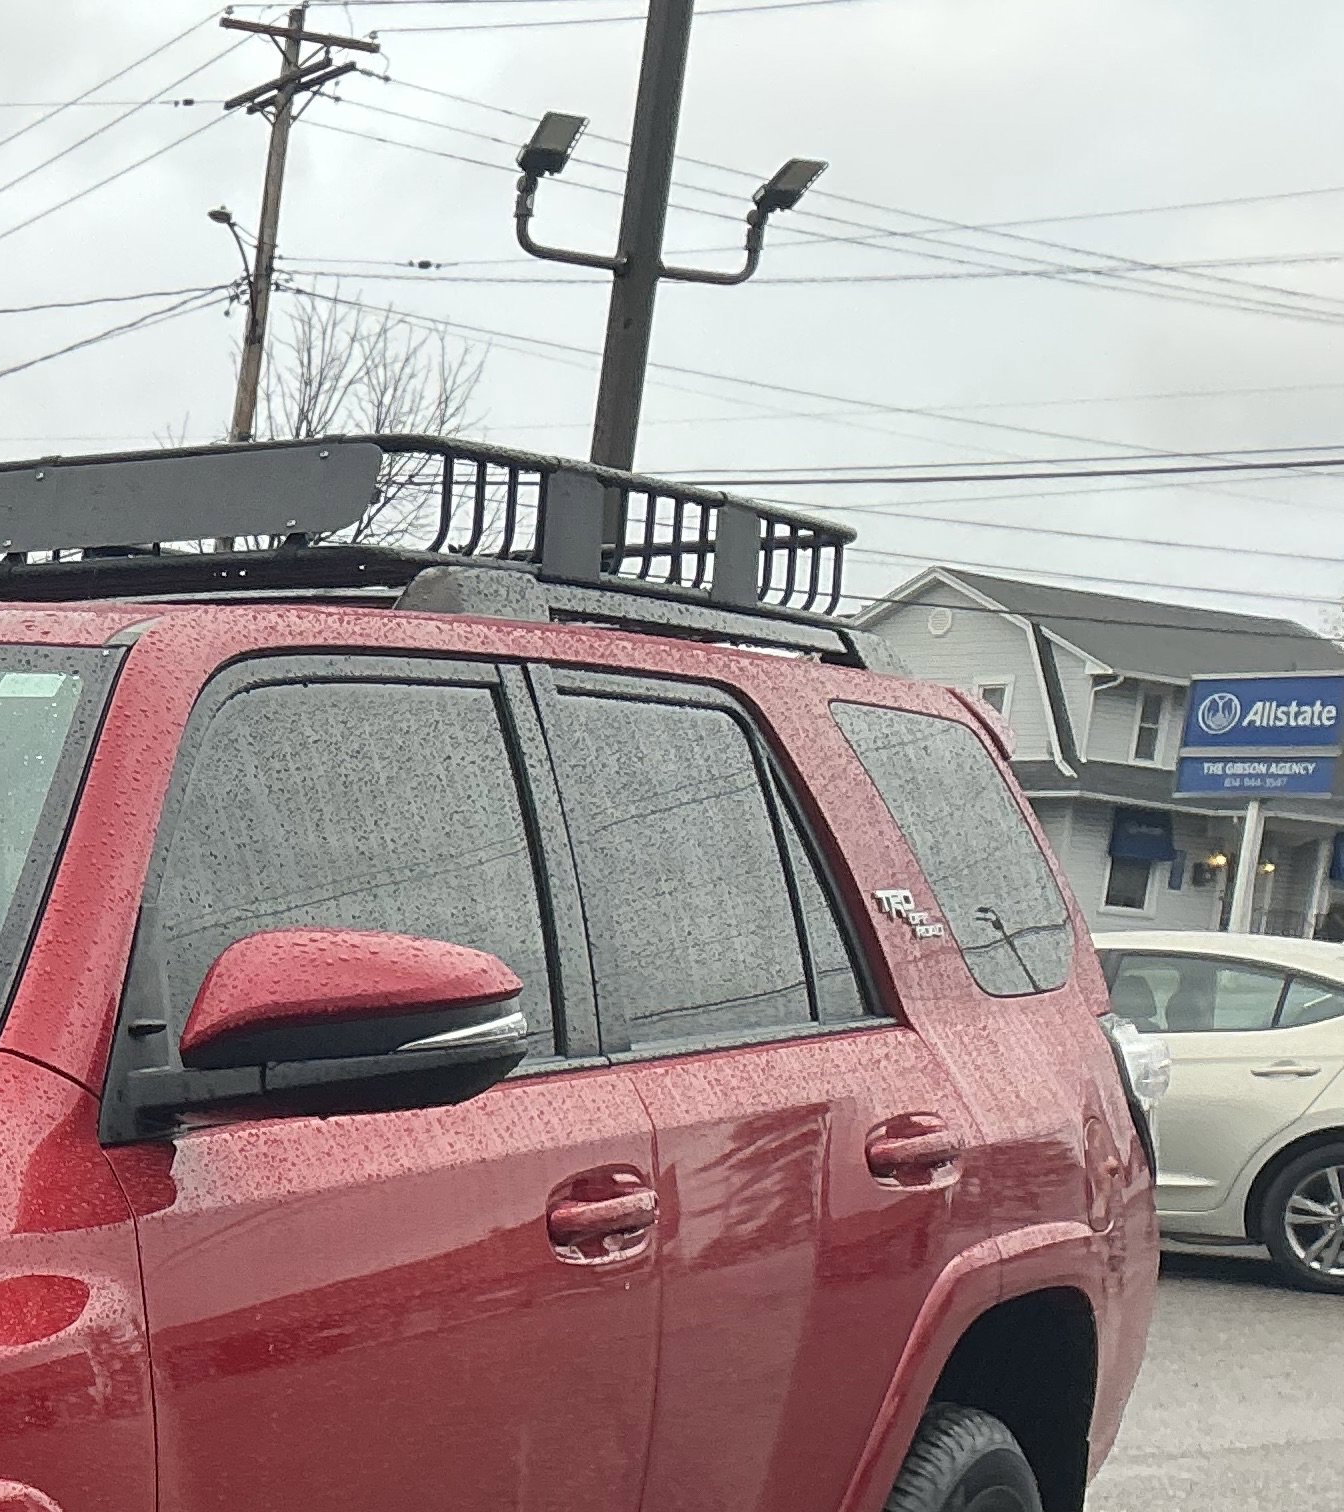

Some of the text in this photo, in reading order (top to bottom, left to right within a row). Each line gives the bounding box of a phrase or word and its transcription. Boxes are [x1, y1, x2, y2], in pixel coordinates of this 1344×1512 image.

[1242, 700, 1337, 727] Allstate
[1203, 762, 1317, 776] THE GIBSON AGENCY
[874, 889, 915, 919] TRD
[916, 923, 945, 938] ROAD
